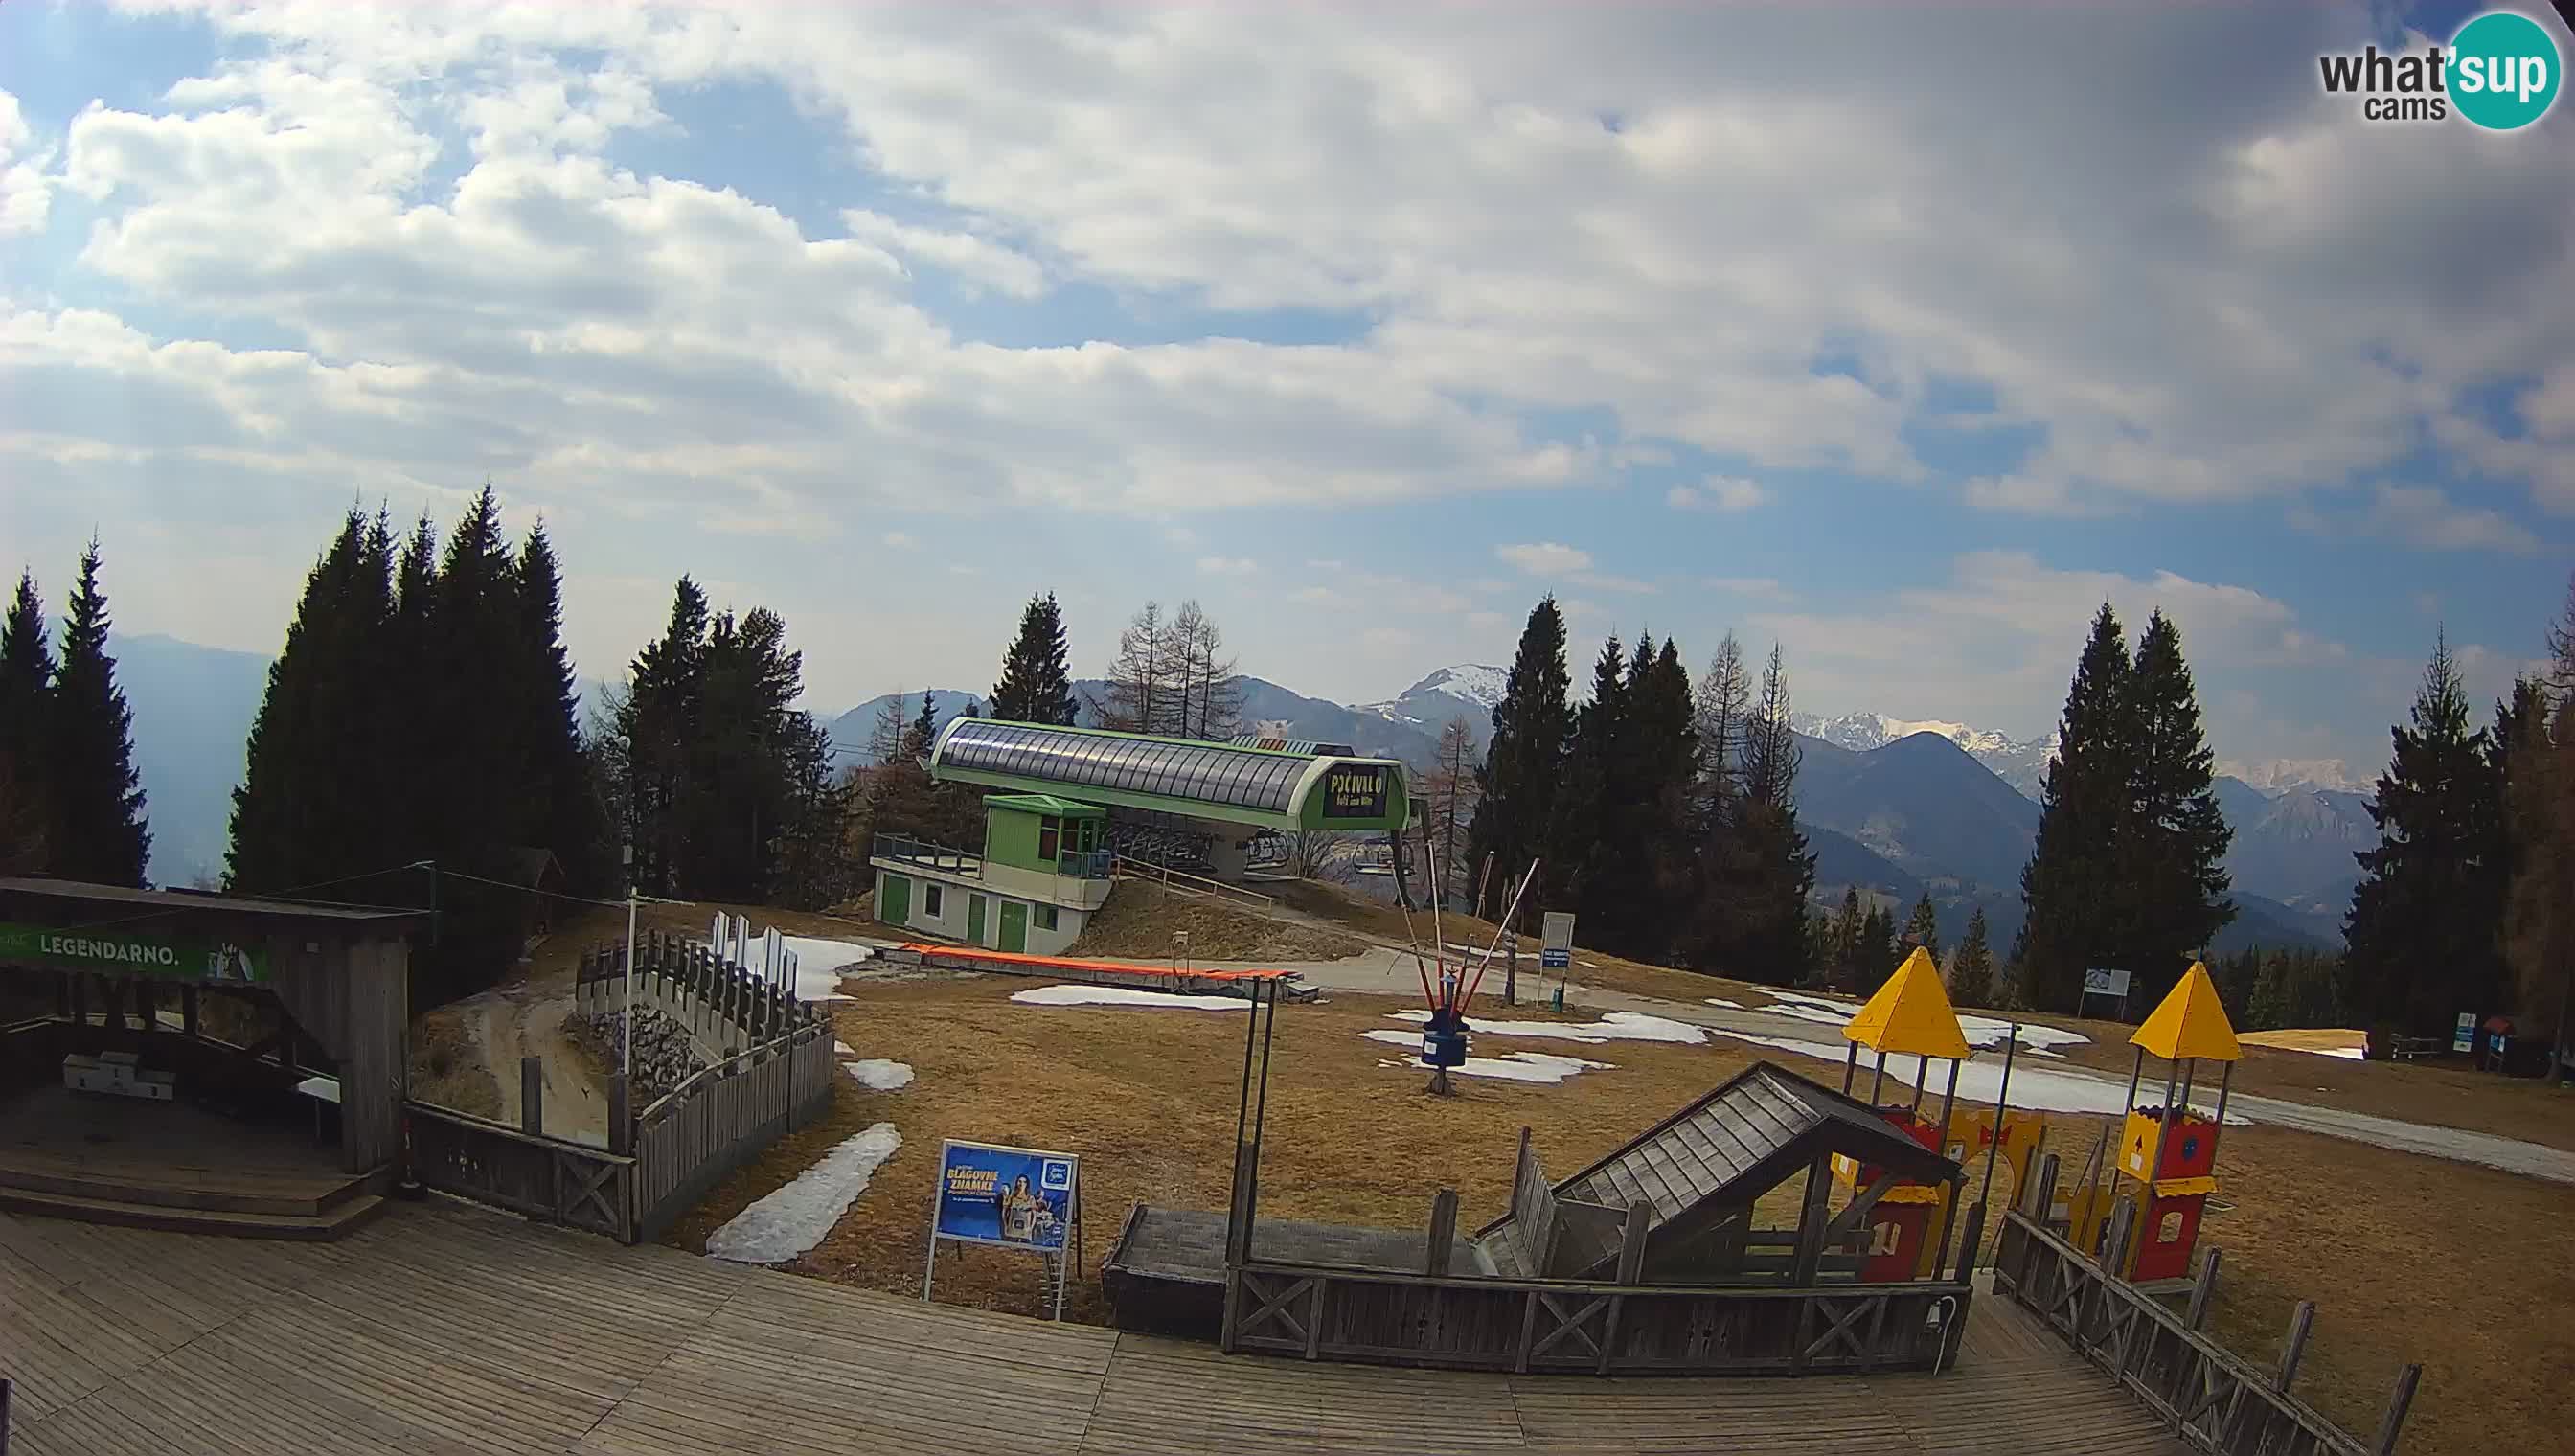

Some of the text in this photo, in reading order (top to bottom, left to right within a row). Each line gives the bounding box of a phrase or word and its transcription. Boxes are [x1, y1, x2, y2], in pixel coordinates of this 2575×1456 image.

[40, 934, 180, 967] LEGENDARNO.
[947, 1169, 999, 1181] BLAGOVNE
[949, 1179, 994, 1191] ZNAMKE
